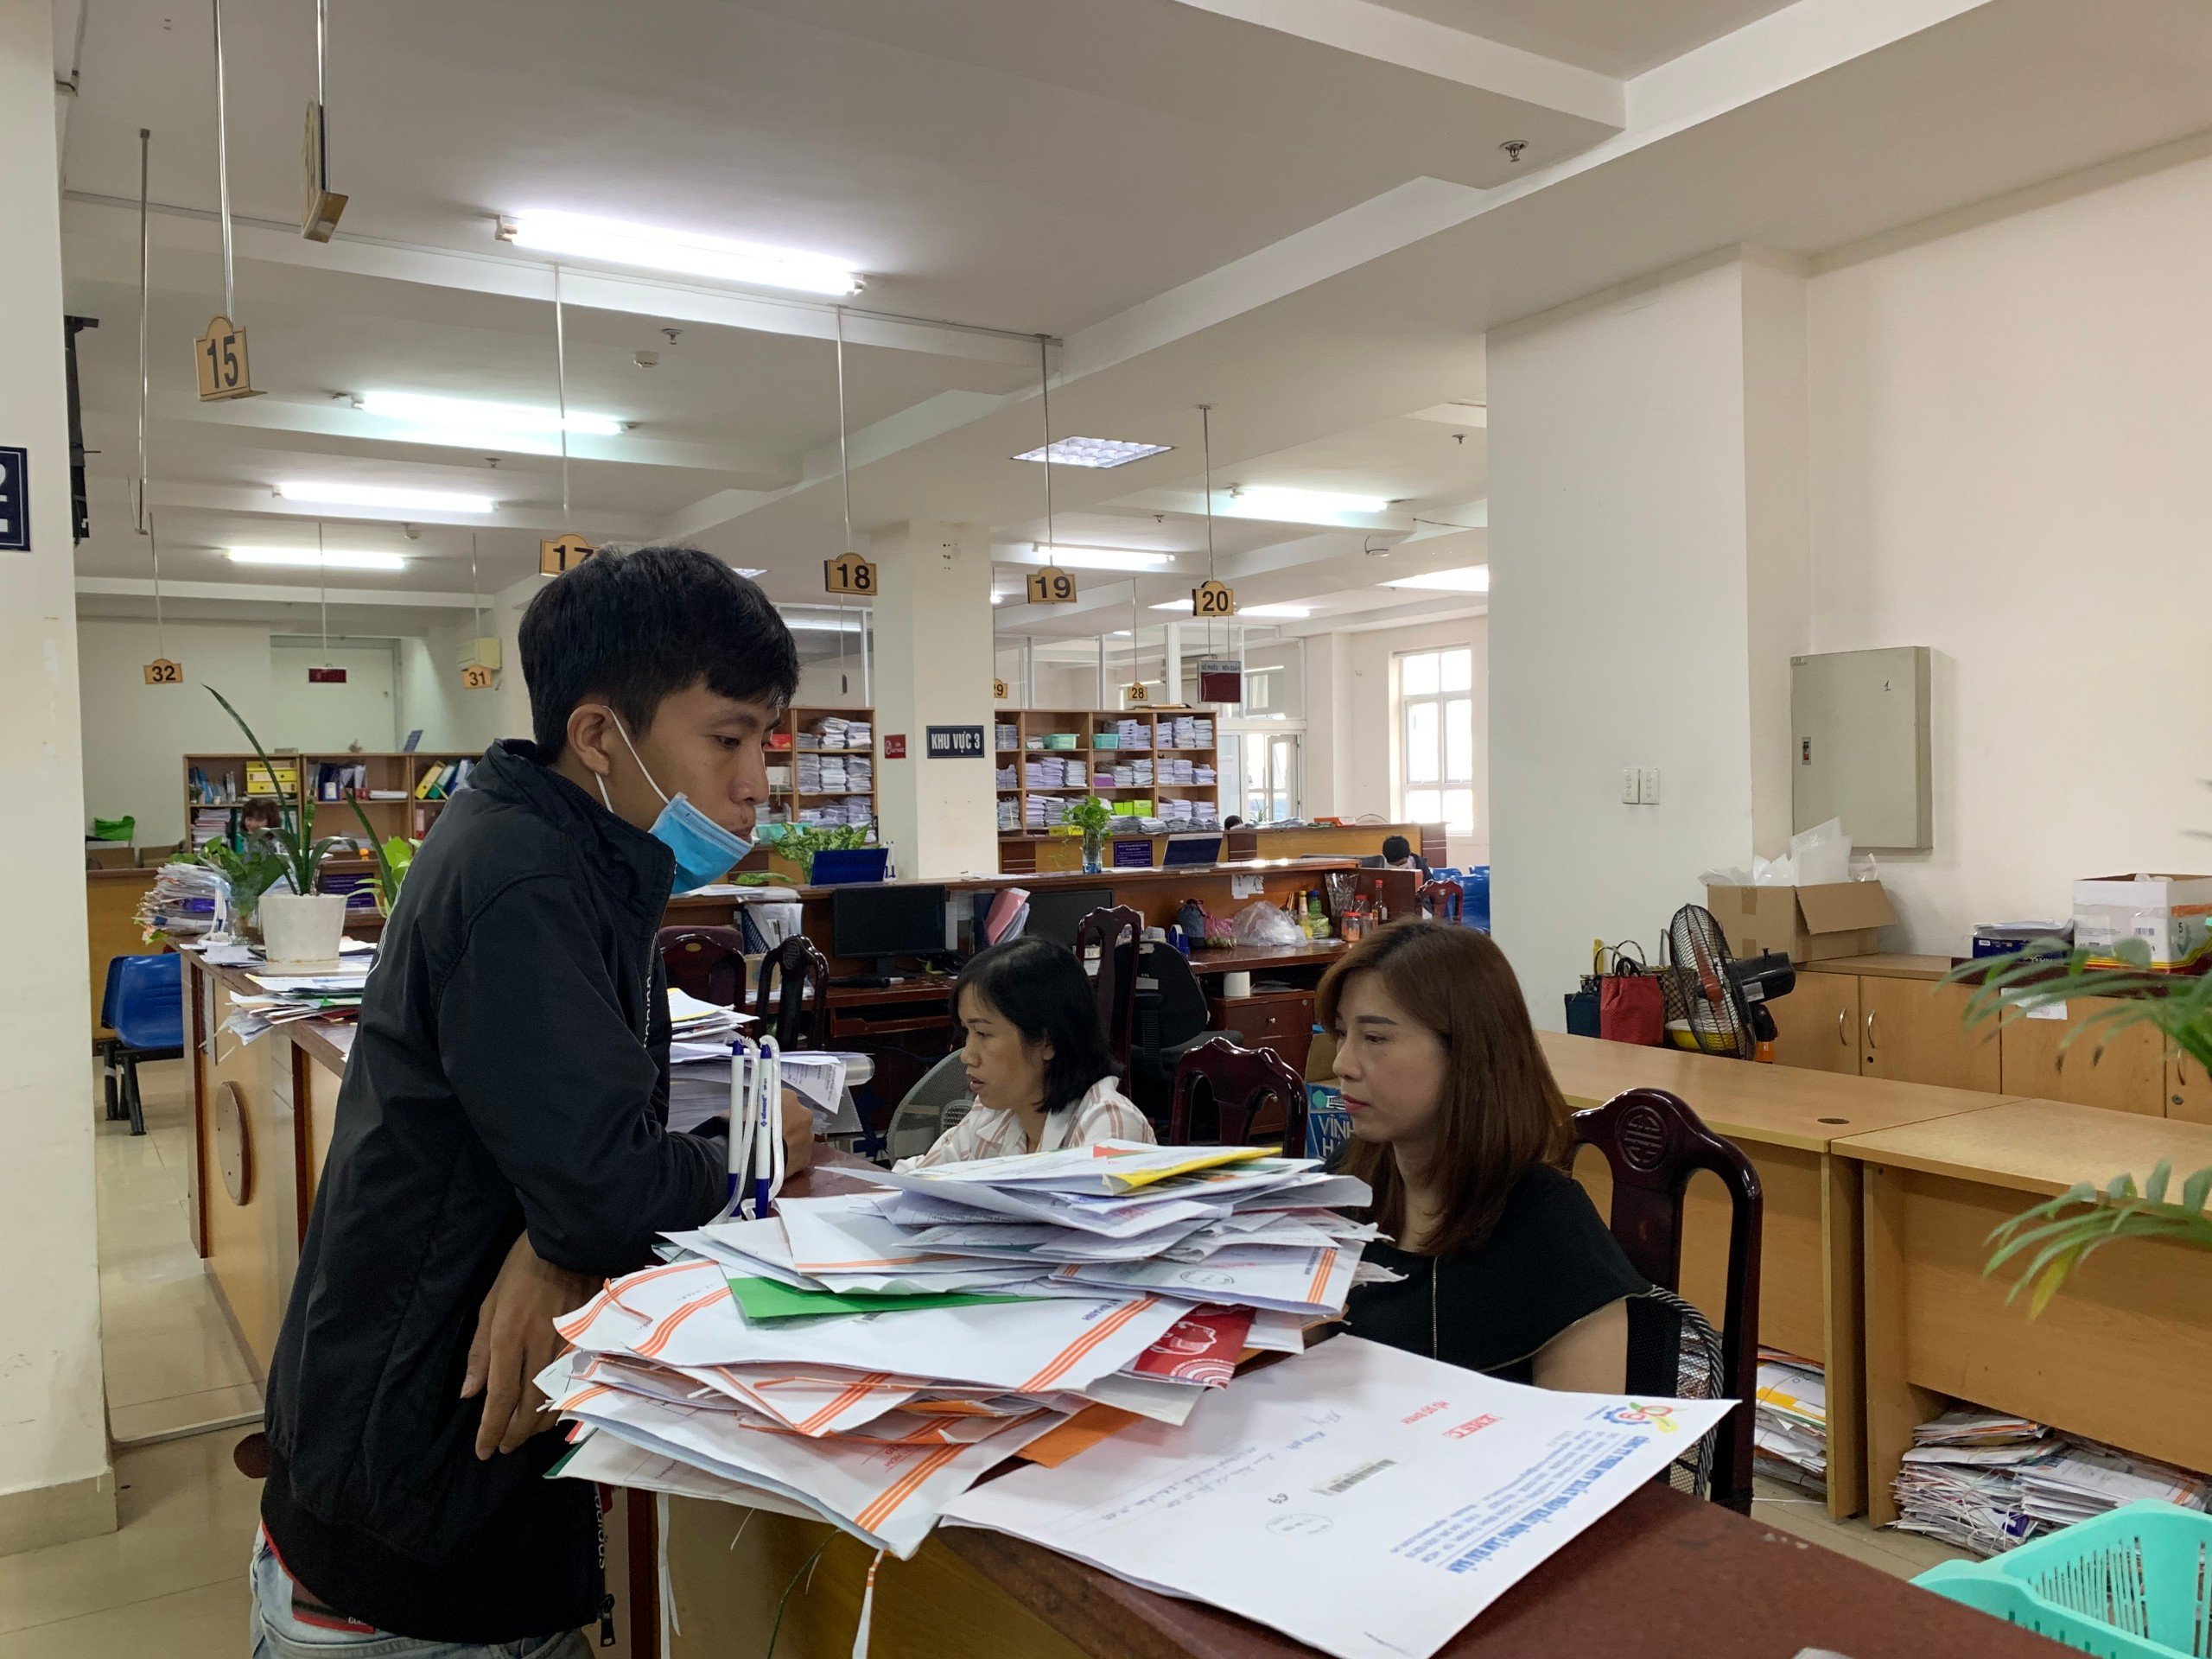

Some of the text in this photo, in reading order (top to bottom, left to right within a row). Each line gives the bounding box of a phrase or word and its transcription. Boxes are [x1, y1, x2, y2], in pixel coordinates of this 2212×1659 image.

[207, 334, 238, 389] 15
[836, 563, 870, 589] 18
[1034, 576, 1071, 598] 19
[1202, 590, 1229, 612] 20
[151, 665, 175, 682] 32
[468, 671, 486, 686] 31
[1132, 687, 1144, 698] 28
[931, 731, 981, 753] KHU VỰC 3
